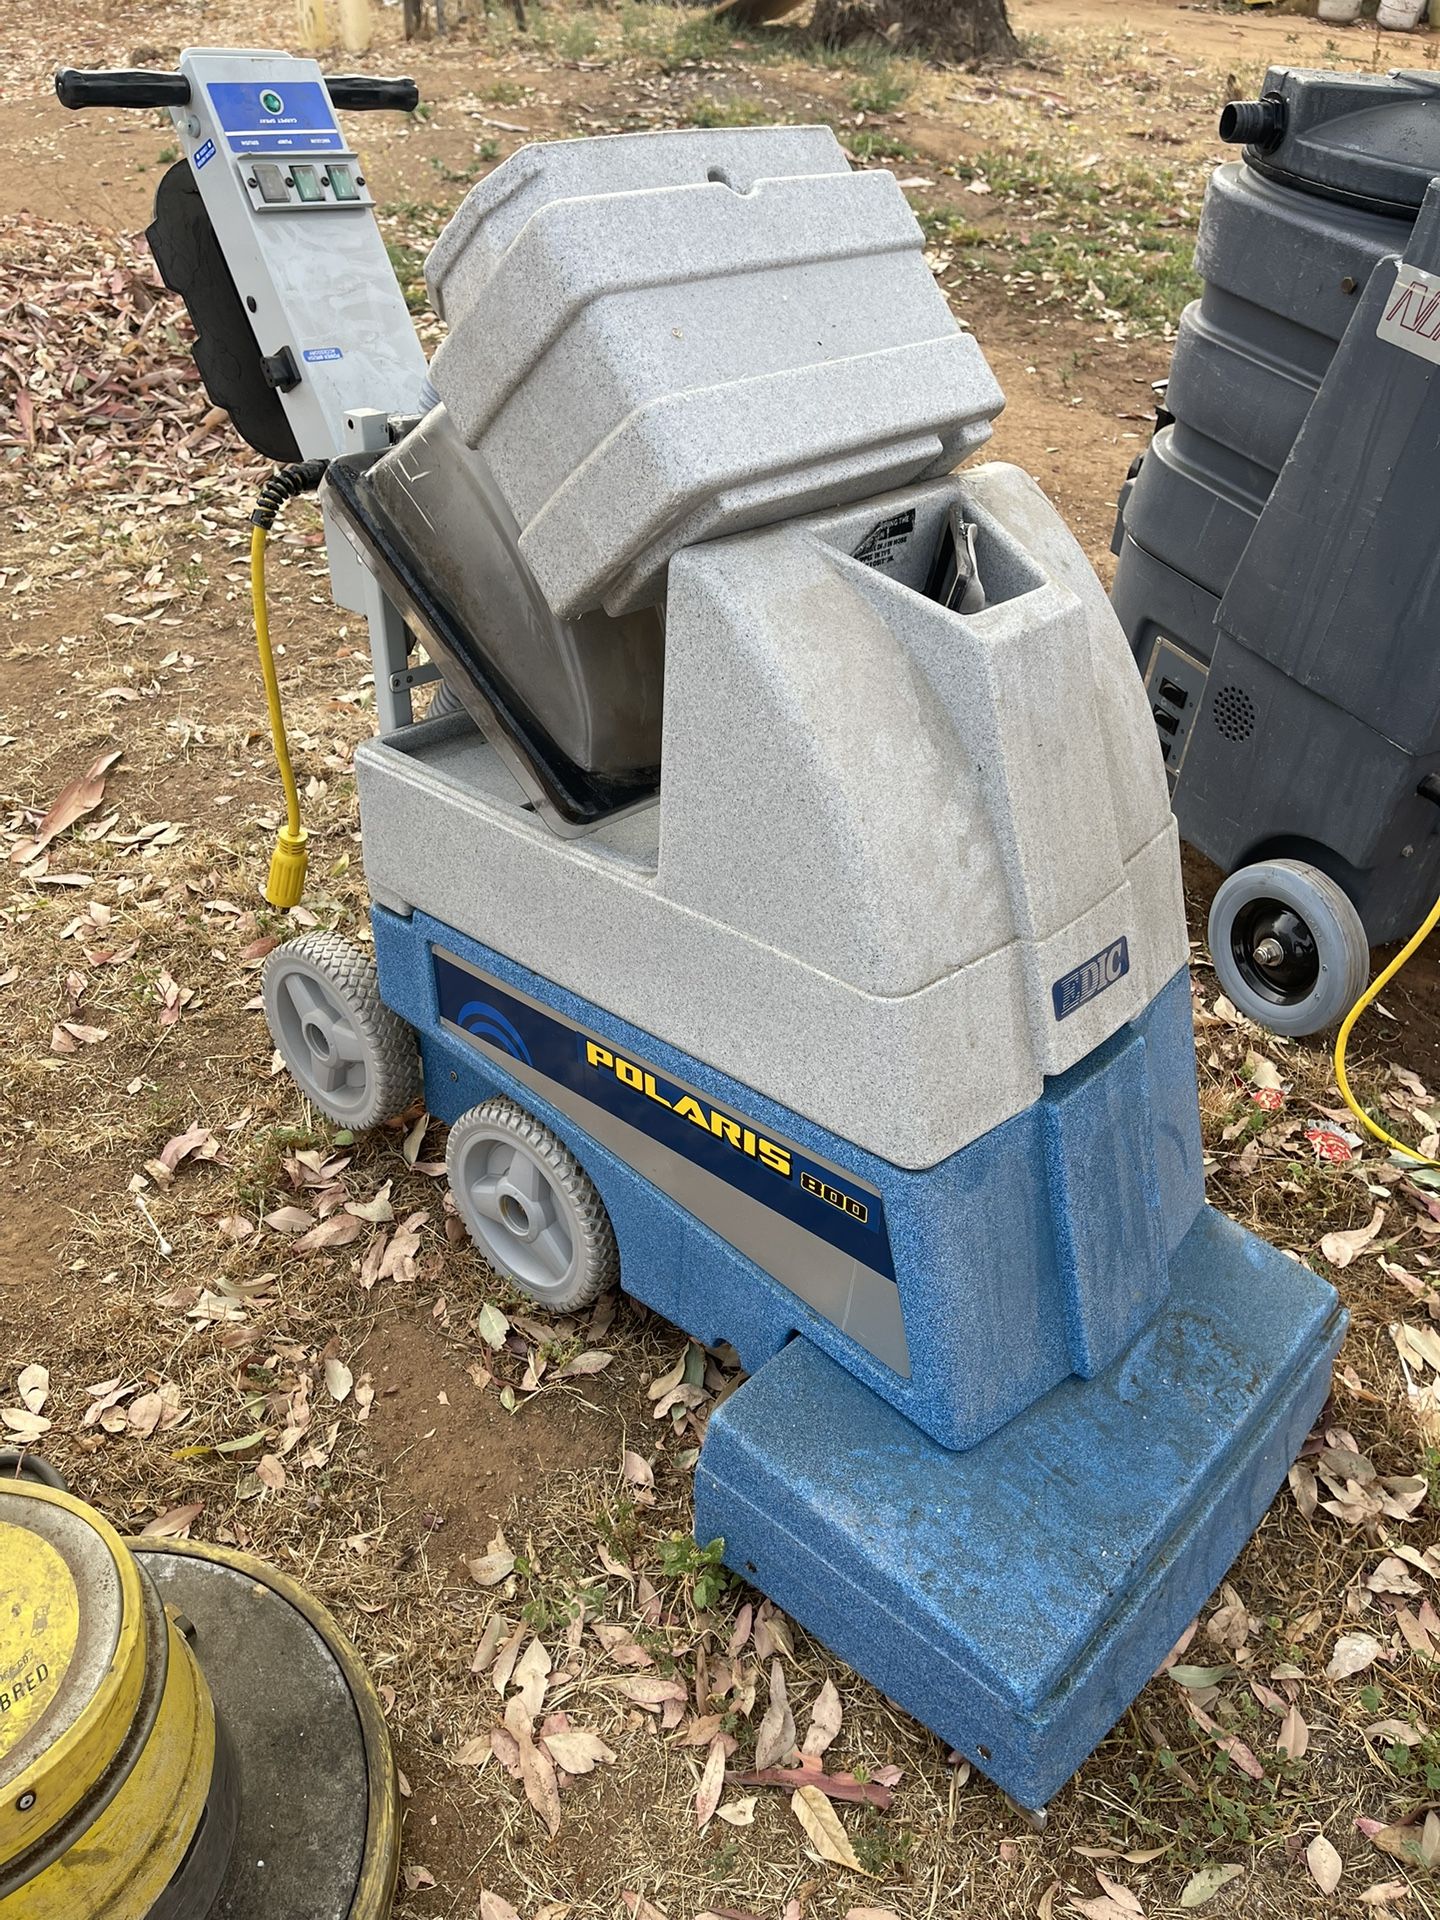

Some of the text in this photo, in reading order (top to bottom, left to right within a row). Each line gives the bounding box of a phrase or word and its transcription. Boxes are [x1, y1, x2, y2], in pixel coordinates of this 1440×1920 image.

[1060, 942, 1122, 1016] EDIC
[586, 1040, 868, 1223] POLARIS 800
